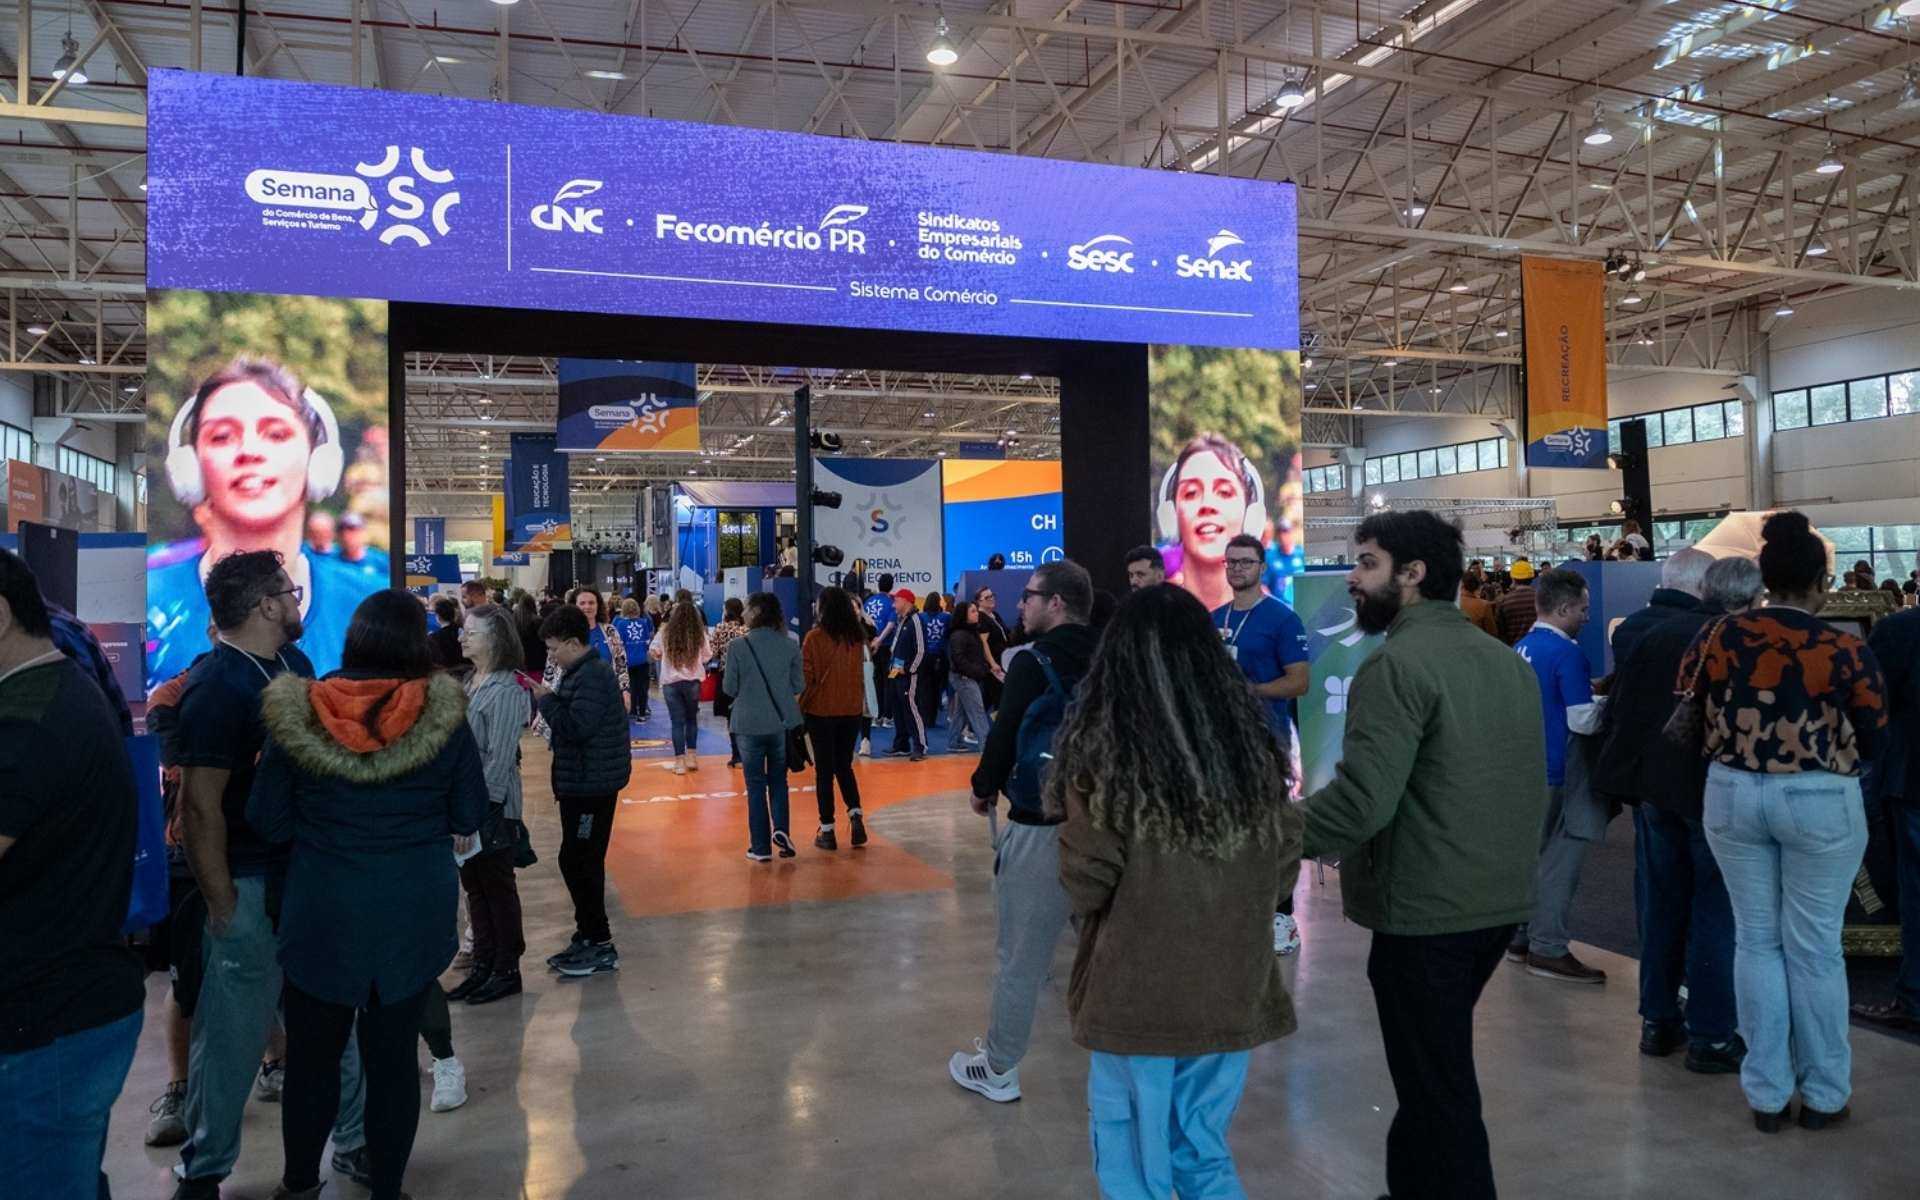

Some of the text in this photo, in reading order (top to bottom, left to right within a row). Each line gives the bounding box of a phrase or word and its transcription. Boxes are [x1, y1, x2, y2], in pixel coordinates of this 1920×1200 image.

[261, 178, 355, 202] Semana
[386, 175, 425, 220] S
[308, 220, 341, 231] Turismo
[530, 203, 604, 235] CNC
[917, 211, 1001, 232] Sindicatos
[656, 213, 867, 254] Fecomércio PR
[918, 227, 1024, 250] Empresariais
[918, 244, 1017, 265] do Comércio
[1067, 244, 1135, 273] Sesc
[1176, 254, 1254, 282] Senac
[850, 280, 999, 305] Sistema Comércio
[1559, 324, 1571, 402] RECREAÇÃO
[870, 509, 889, 533] S
[1031, 514, 1057, 531] CH
[868, 558, 902, 570] RENA
[1010, 551, 1033, 564] 15h
